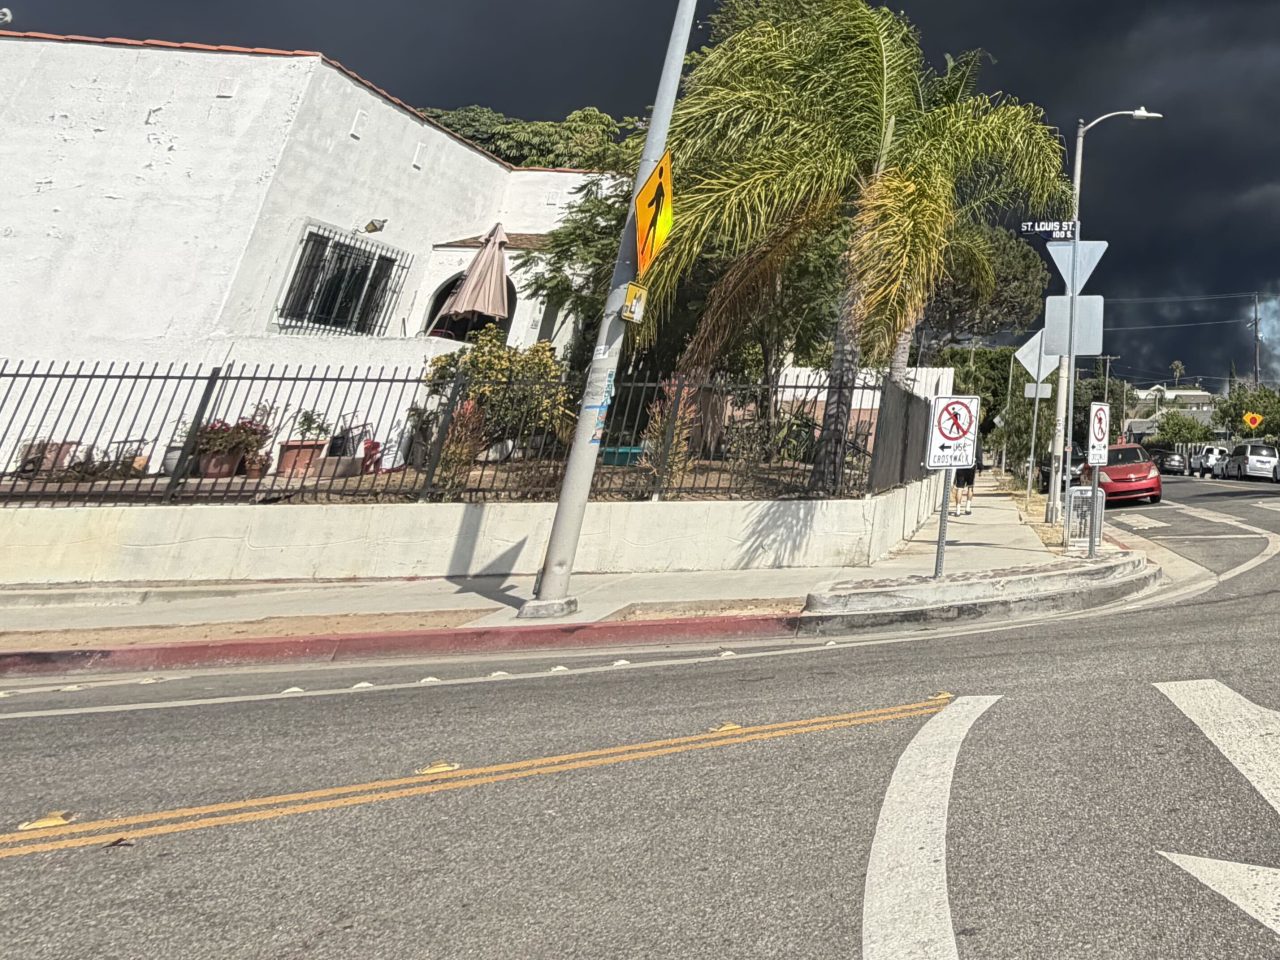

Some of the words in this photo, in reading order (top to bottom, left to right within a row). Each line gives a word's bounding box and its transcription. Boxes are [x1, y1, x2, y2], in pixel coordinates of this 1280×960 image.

[1021, 222, 1034, 231] ST.
[1034, 221, 1060, 231] LOUIS
[1061, 221, 1075, 231] ST.
